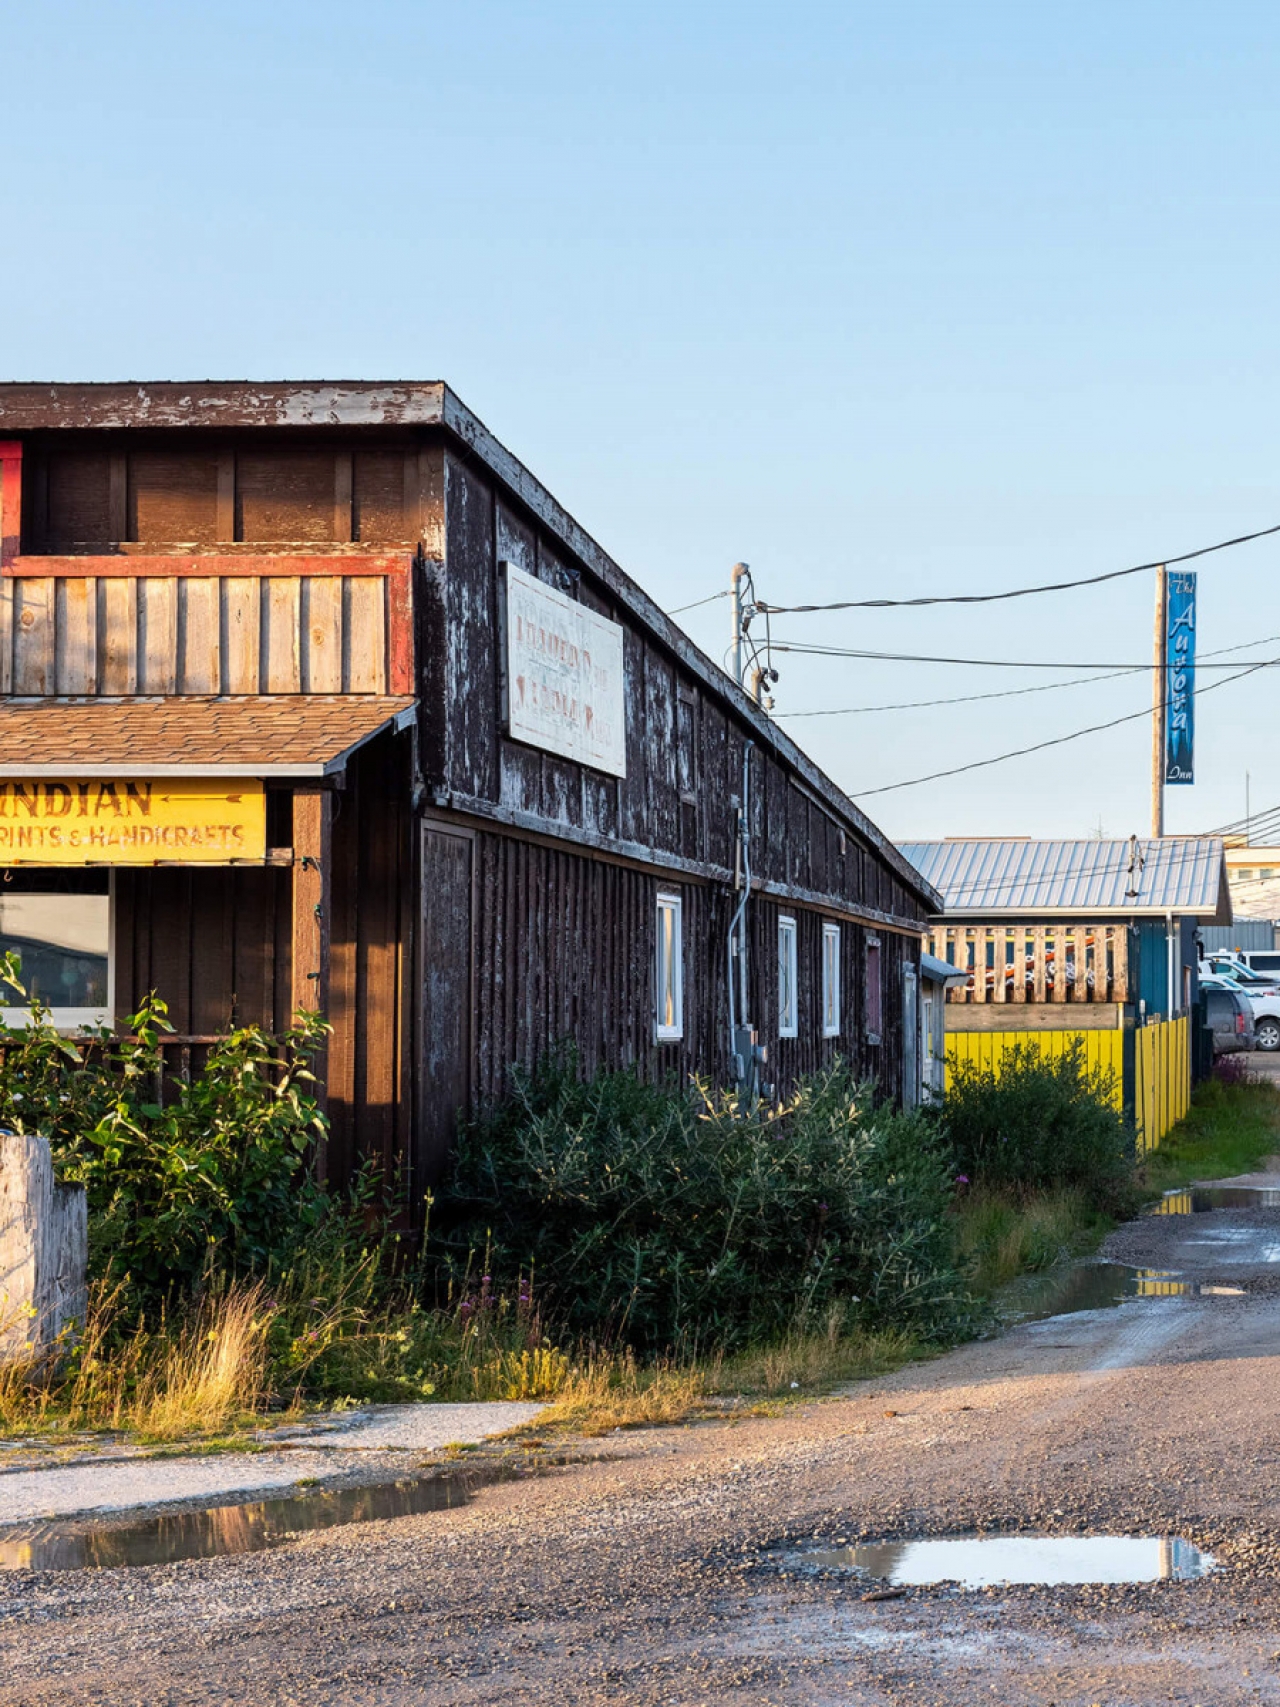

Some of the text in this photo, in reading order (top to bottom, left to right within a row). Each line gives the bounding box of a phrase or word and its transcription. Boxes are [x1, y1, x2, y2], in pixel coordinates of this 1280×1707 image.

[1169, 579, 1194, 594] The
[1169, 601, 1195, 729] Aurora
[1167, 765, 1192, 779] Inn
[0, 782, 152, 818] INDIAN
[69, 829, 82, 847] &
[90, 825, 245, 847] HANDICRAFTS
